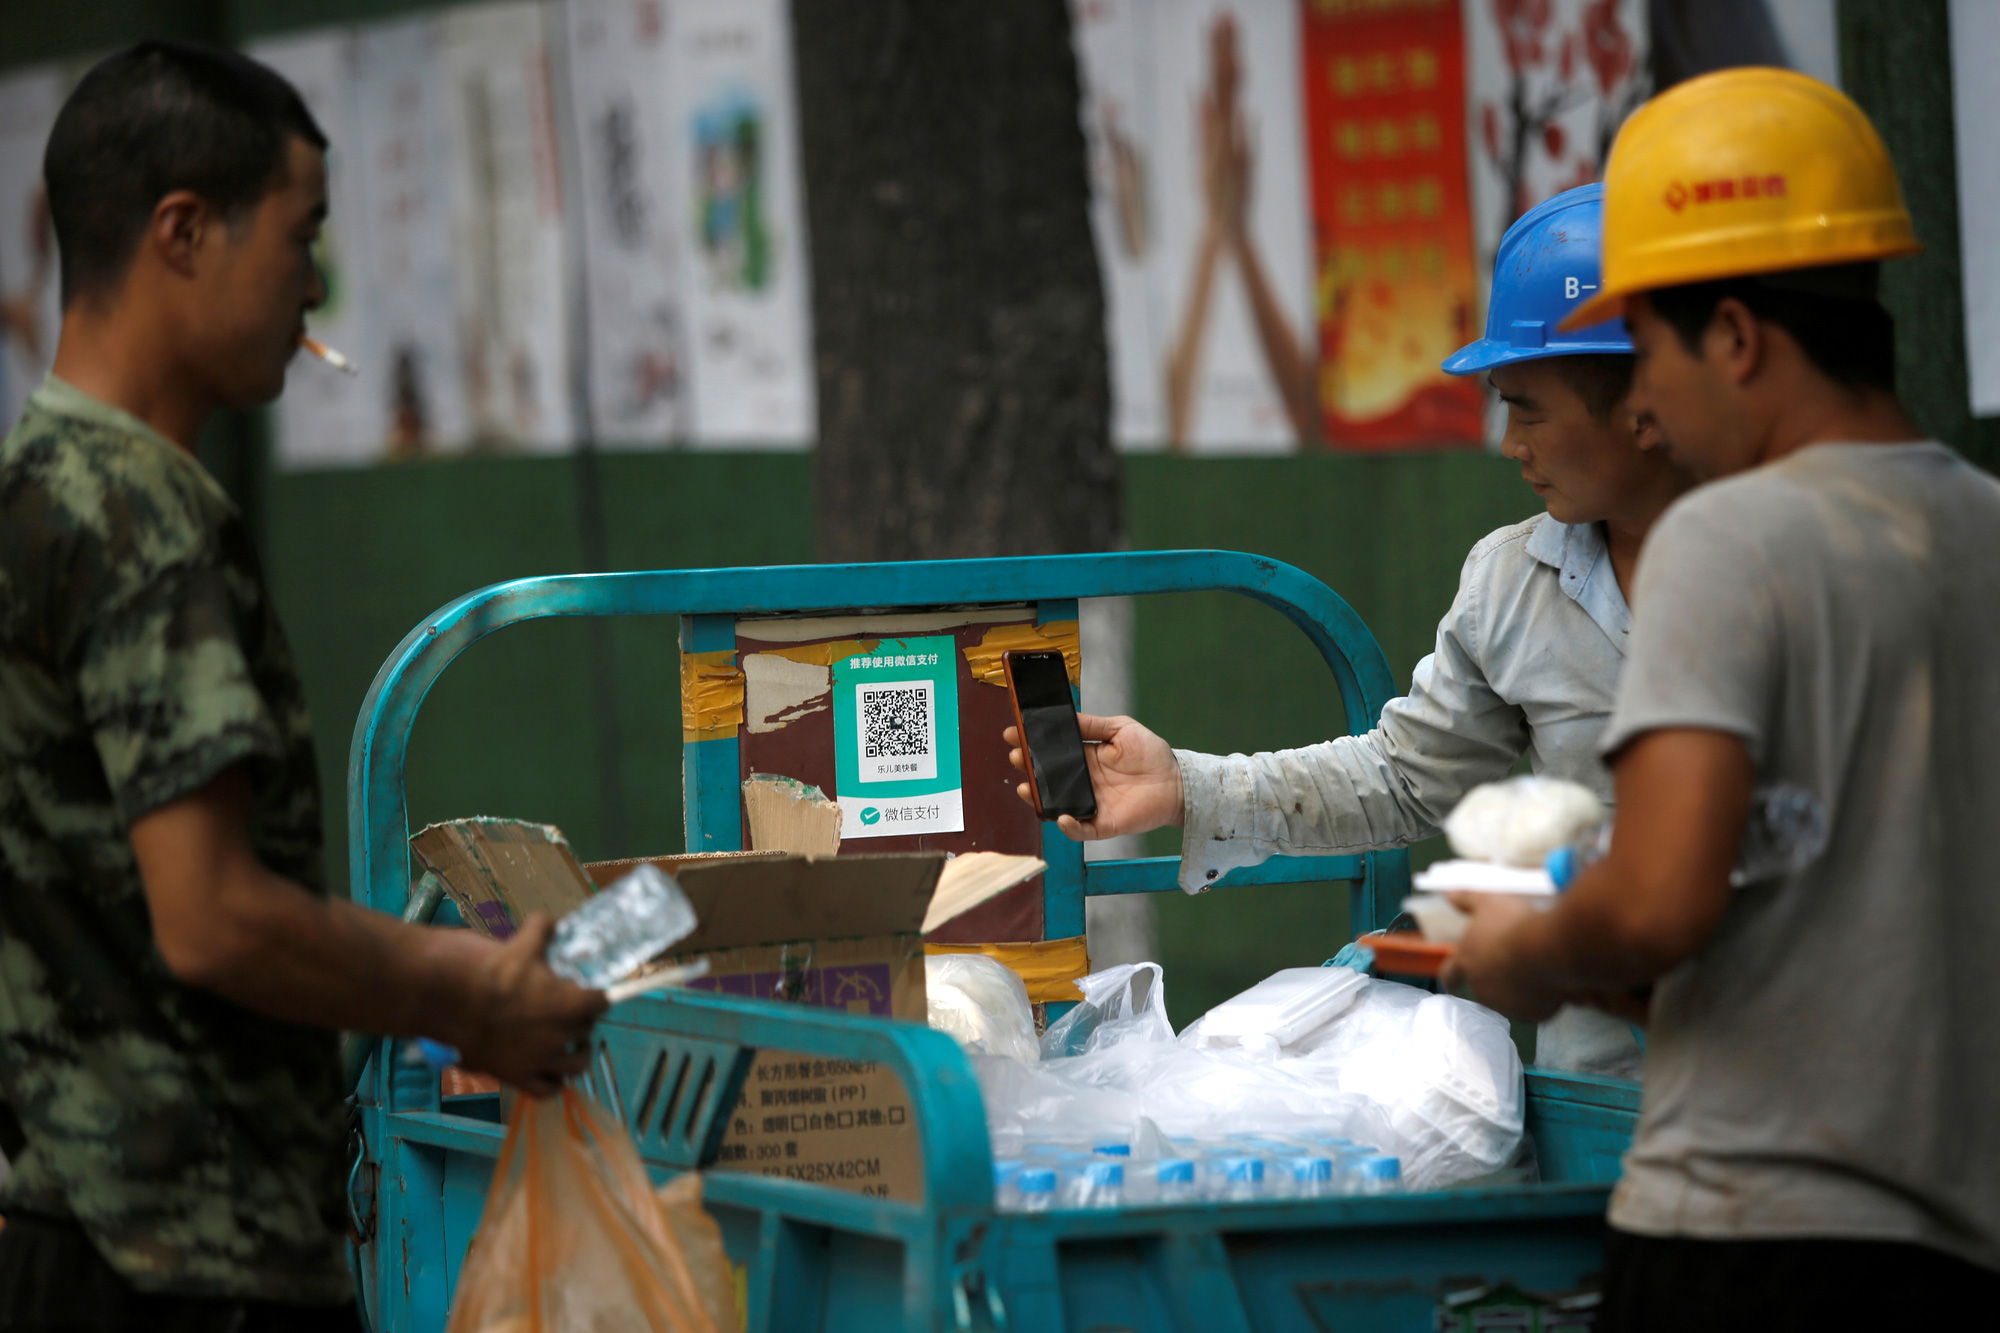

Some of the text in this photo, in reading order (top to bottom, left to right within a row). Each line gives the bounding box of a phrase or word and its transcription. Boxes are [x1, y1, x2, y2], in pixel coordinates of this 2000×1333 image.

[850, 653, 939, 670] 推荐使用微信支付
[877, 763, 918, 774] 乐儿美快餐
[884, 805, 940, 822] 微信支付
